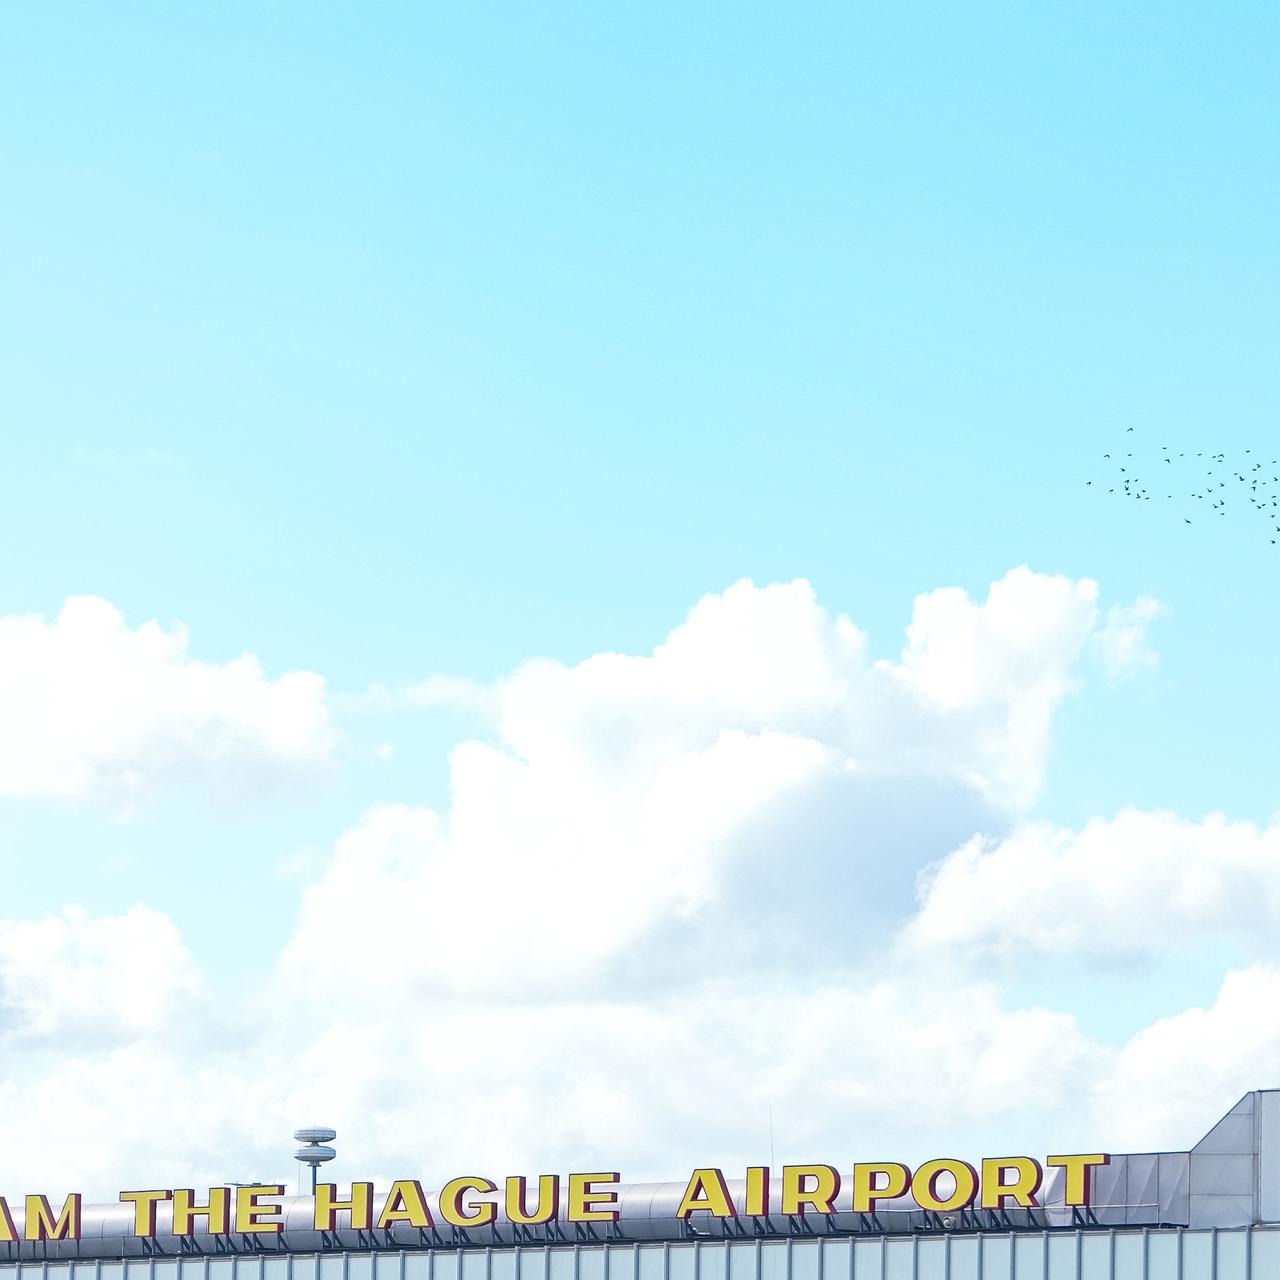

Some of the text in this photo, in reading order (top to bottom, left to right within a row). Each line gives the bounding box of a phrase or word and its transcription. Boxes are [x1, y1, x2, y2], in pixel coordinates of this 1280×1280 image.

[120, 1183, 286, 1238] THE
[314, 1172, 620, 1230] HAGUE
[675, 1153, 1110, 1219] AIRPORT
